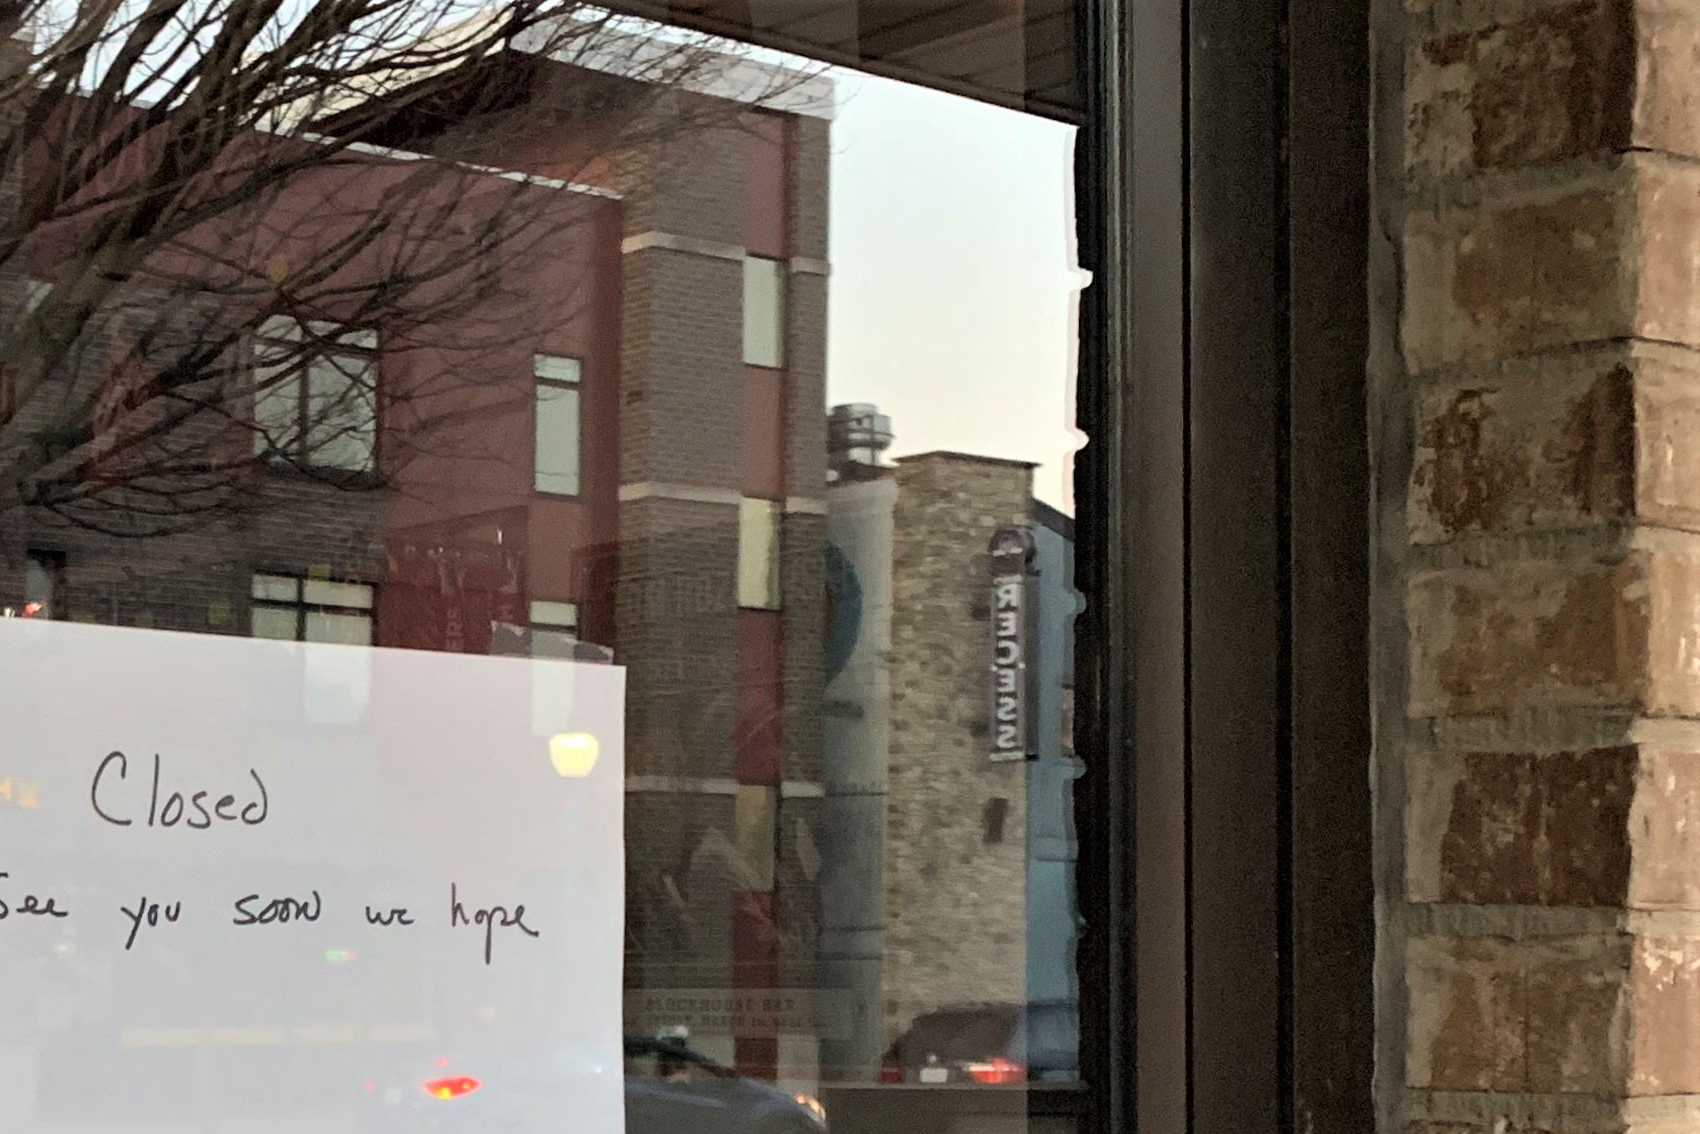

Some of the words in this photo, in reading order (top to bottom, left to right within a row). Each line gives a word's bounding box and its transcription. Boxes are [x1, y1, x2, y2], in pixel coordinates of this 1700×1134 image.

[91, 750, 269, 828] Closed
[120, 896, 182, 950] you
[232, 889, 322, 925] soon
[365, 906, 415, 926] we
[450, 883, 541, 965] hope
